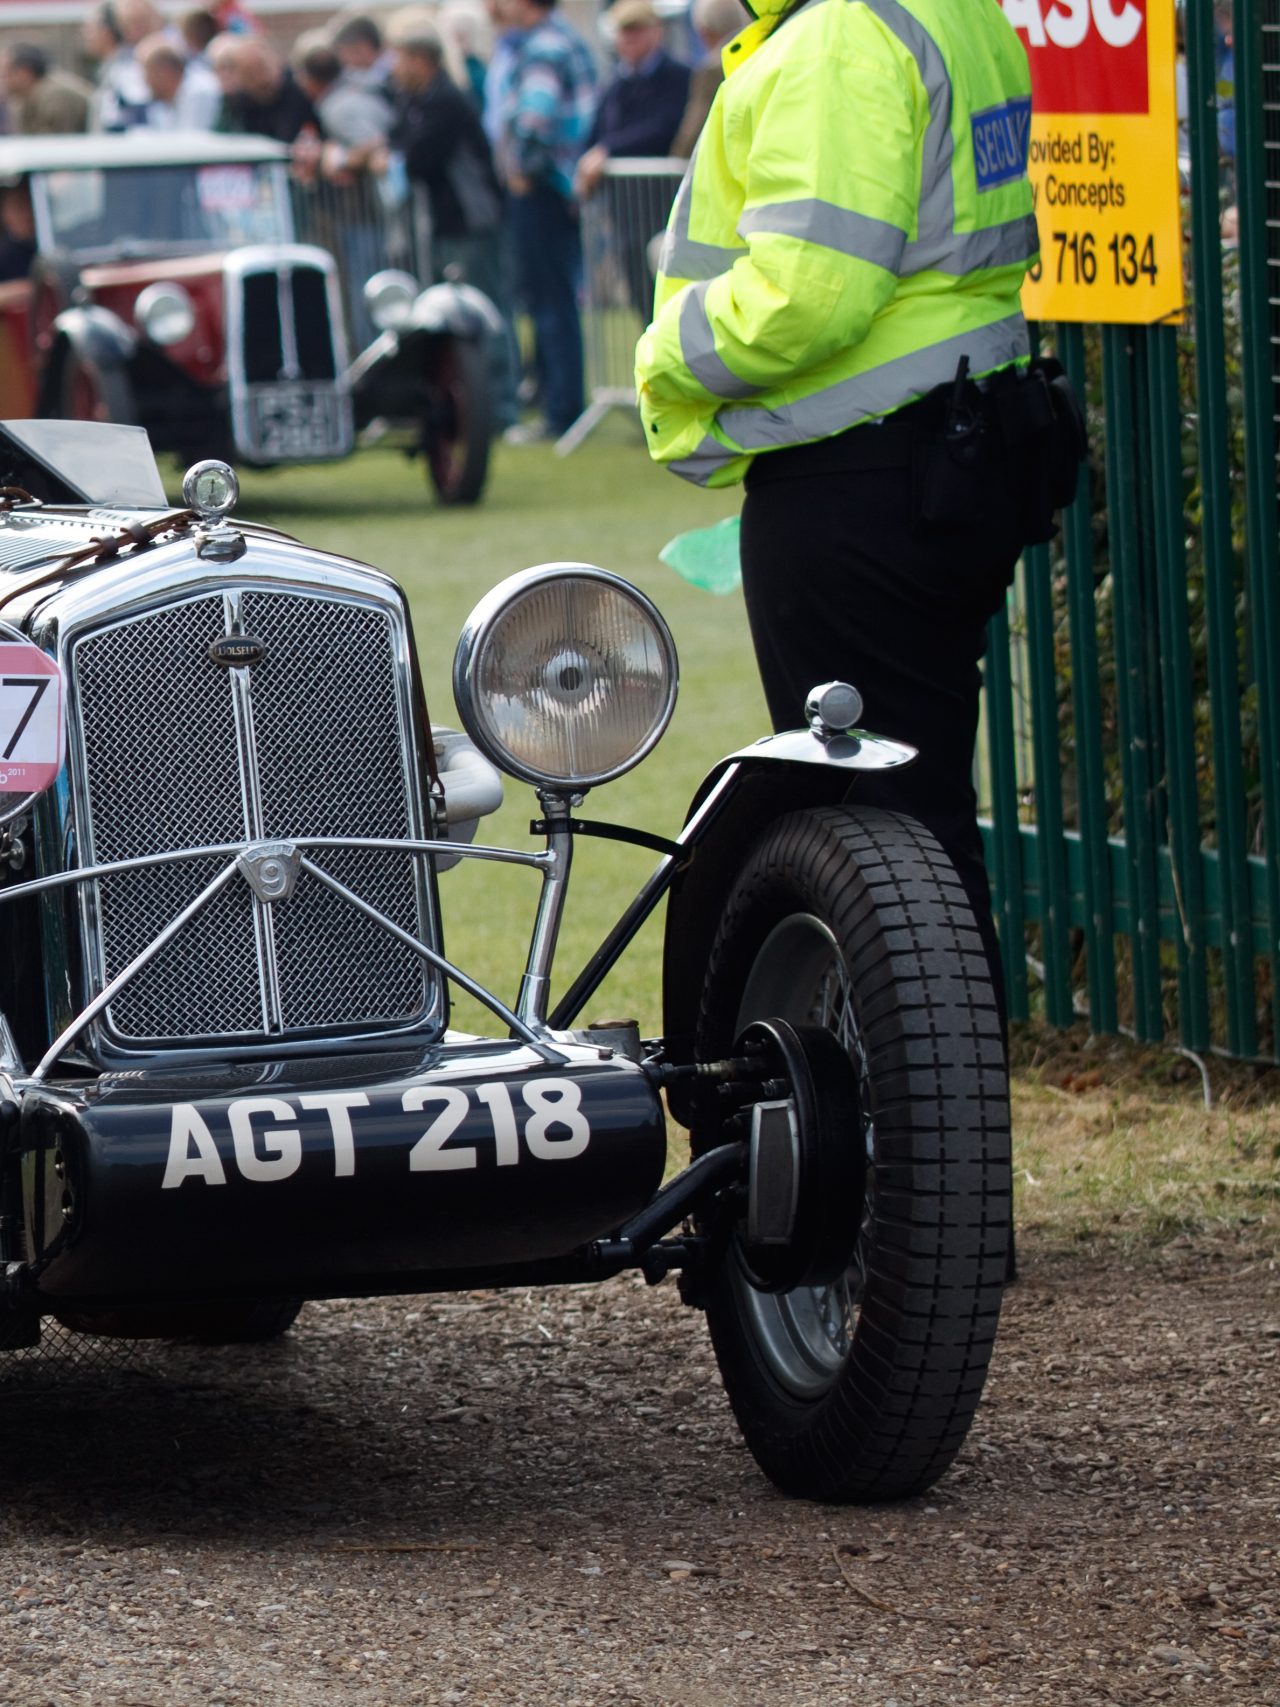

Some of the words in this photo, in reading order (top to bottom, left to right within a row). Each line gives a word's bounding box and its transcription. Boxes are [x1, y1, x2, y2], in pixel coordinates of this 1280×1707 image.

[1030, 132, 1082, 163] ovided
[1088, 133, 1115, 171] By:
[1045, 174, 1126, 213] Concepts
[1053, 231, 1097, 285] 716
[1108, 233, 1157, 286] 134
[260, 858, 287, 896] 9
[161, 1091, 370, 1189] AGT
[401, 1077, 591, 1172] 218
